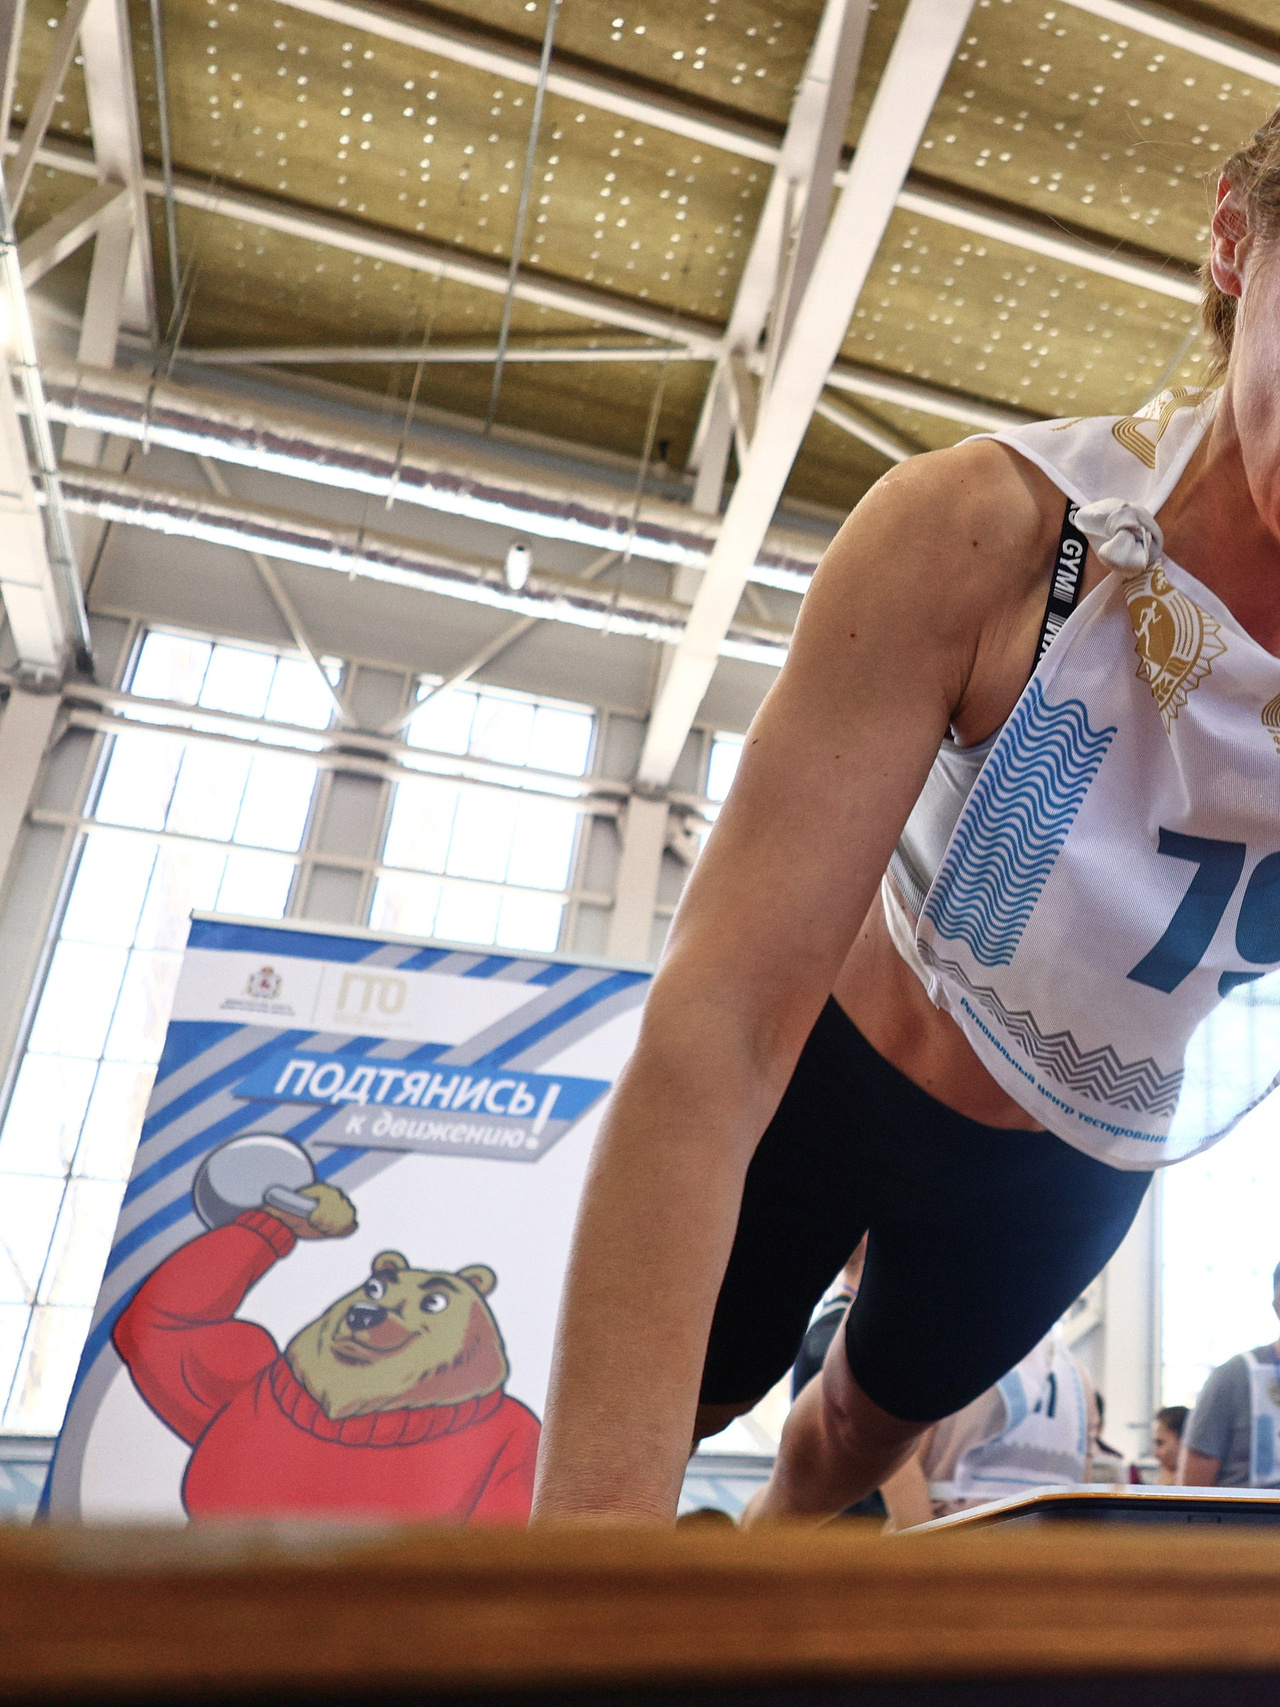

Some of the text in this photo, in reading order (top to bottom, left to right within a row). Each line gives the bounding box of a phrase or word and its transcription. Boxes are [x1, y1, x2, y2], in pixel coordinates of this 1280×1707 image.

[1054, 538, 1084, 595] GYM
[274, 1058, 562, 1149] ПОДТЯНИСЬ!
[345, 1110, 526, 1149] к движению
[1037, 1083, 1075, 1115] центр
[1078, 1111, 1169, 1143] тестировани
